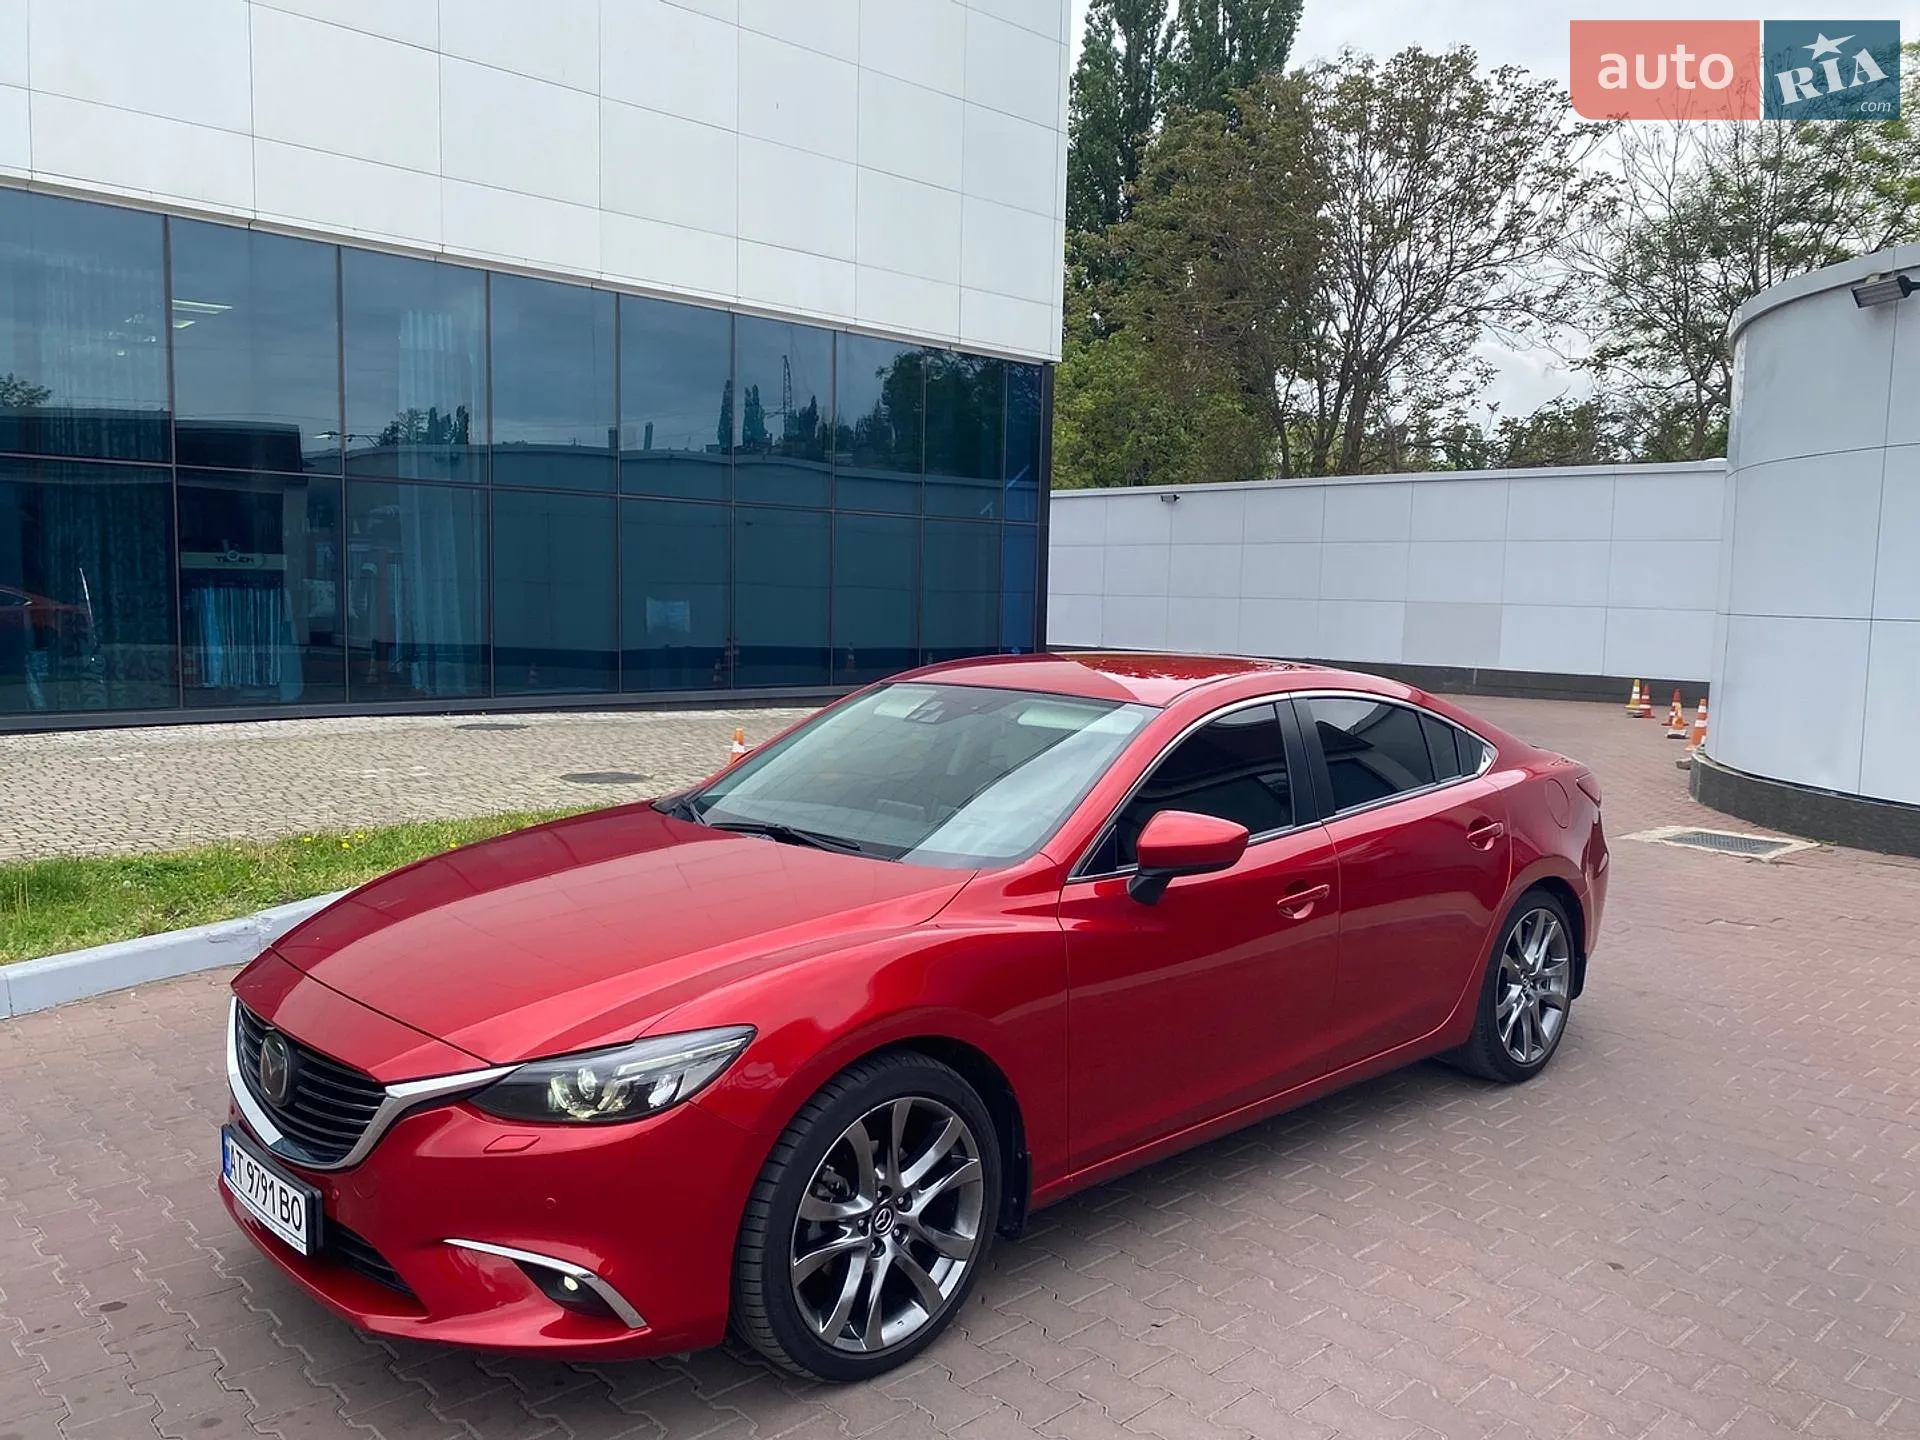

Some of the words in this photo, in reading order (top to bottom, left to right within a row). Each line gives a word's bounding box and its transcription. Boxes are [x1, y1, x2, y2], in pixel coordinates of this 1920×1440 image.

[230, 1145, 243, 1184] AT
[246, 1161, 276, 1215] 9791
[279, 1186, 302, 1232] BO
